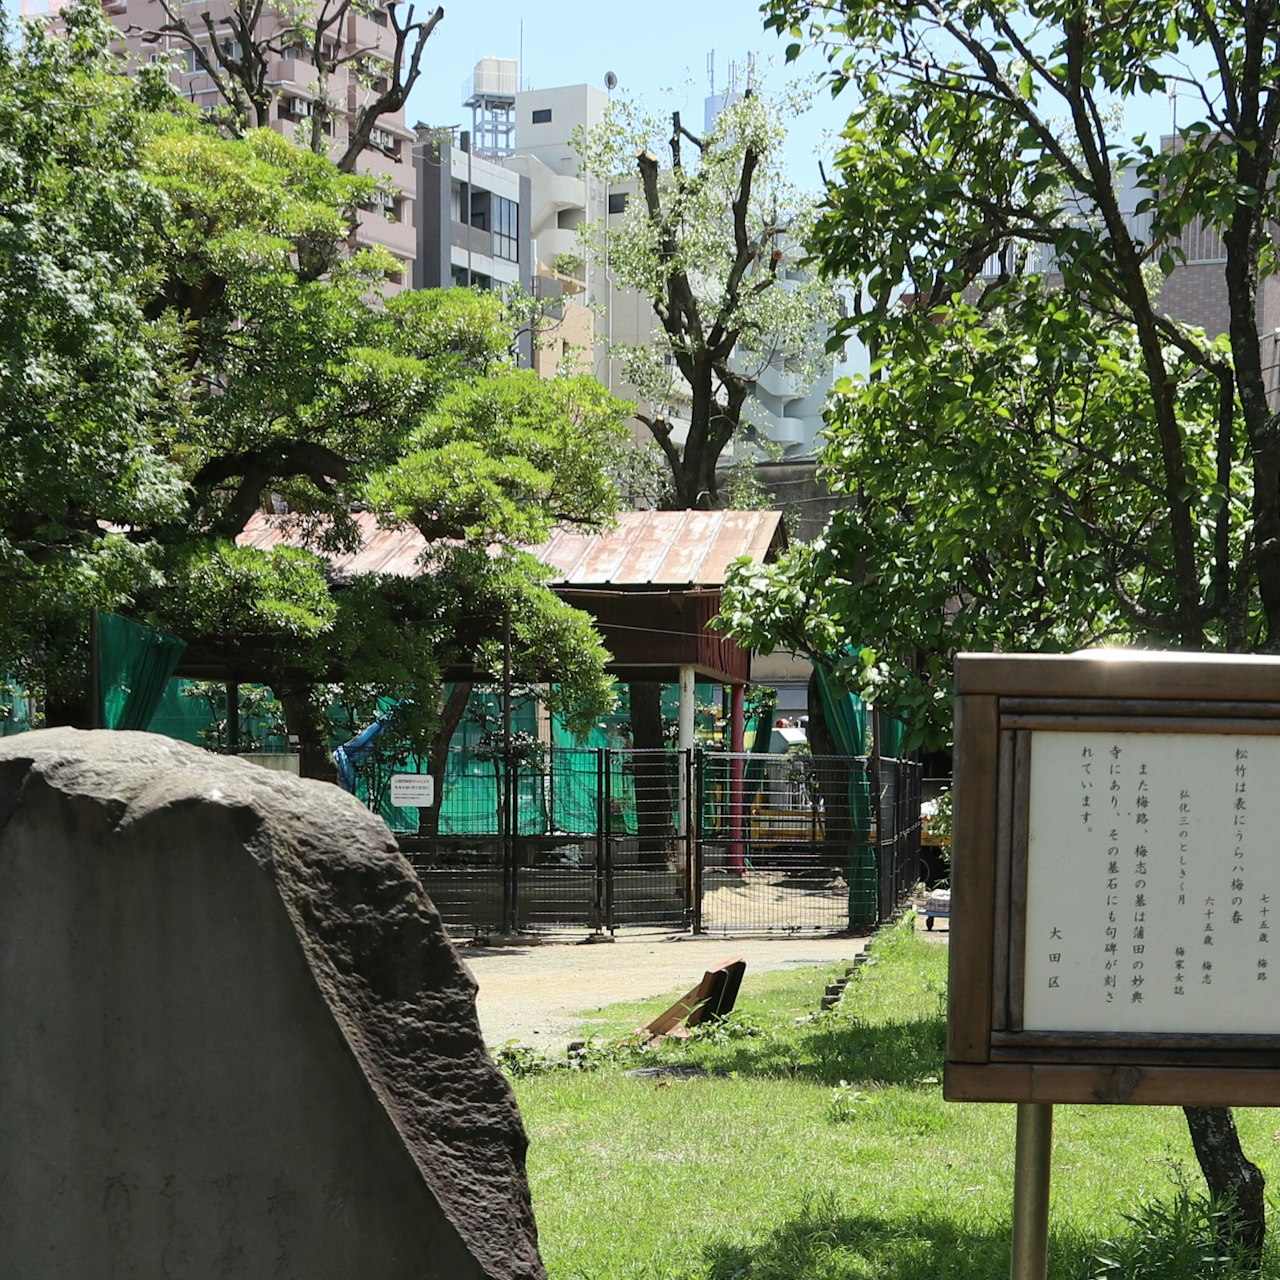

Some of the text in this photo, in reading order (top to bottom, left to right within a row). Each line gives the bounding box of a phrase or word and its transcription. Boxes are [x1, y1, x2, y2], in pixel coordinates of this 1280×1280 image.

[1080, 745, 1094, 833] れています。
[1103, 744, 1122, 1004] 寺にあり、その墓石にも句碑が刻さ
[1130, 763, 1150, 1004] また梅路、梅志の墓は蒲田の妙典
[1048, 926, 1063, 989] 大田区
[1201, 896, 1215, 985] 六十五歳 梅志
[1256, 893, 1270, 982] 七十五歳 梅路
